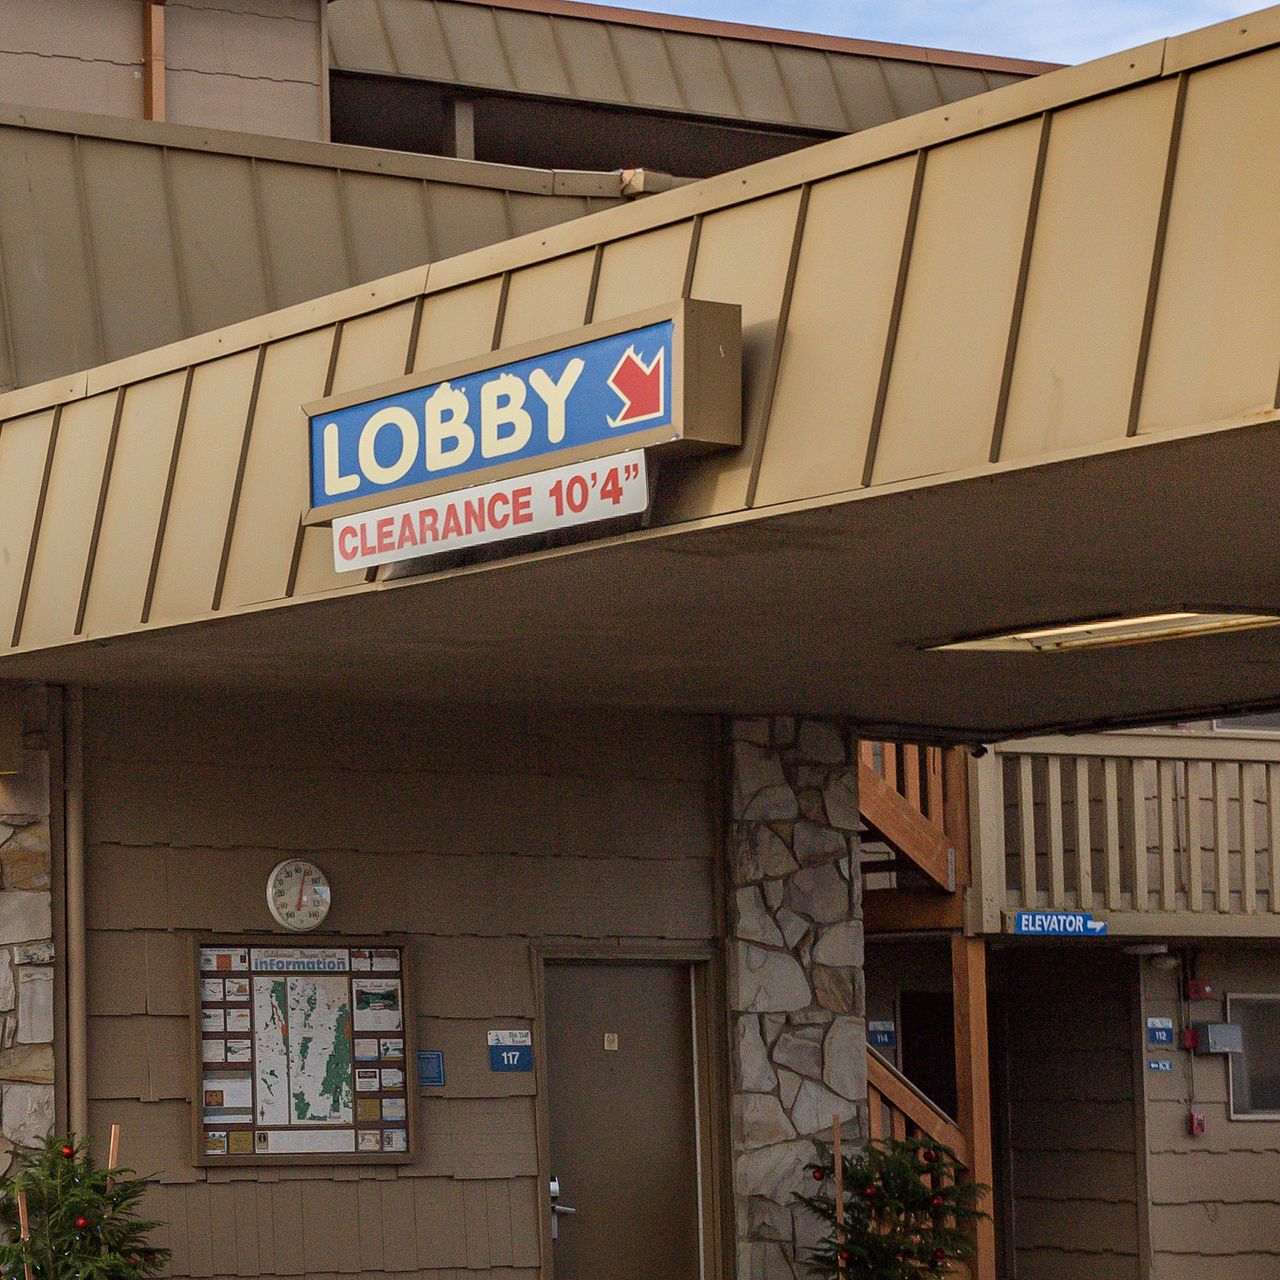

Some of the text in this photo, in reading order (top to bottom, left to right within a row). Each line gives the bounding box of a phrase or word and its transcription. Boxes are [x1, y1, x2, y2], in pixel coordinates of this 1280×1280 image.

[324, 358, 585, 496] LOBBY
[338, 487, 533, 561] CLEARANCE
[1021, 914, 1084, 932] ELEVATOR
[254, 958, 345, 970] information
[501, 1051, 520, 1065] 117
